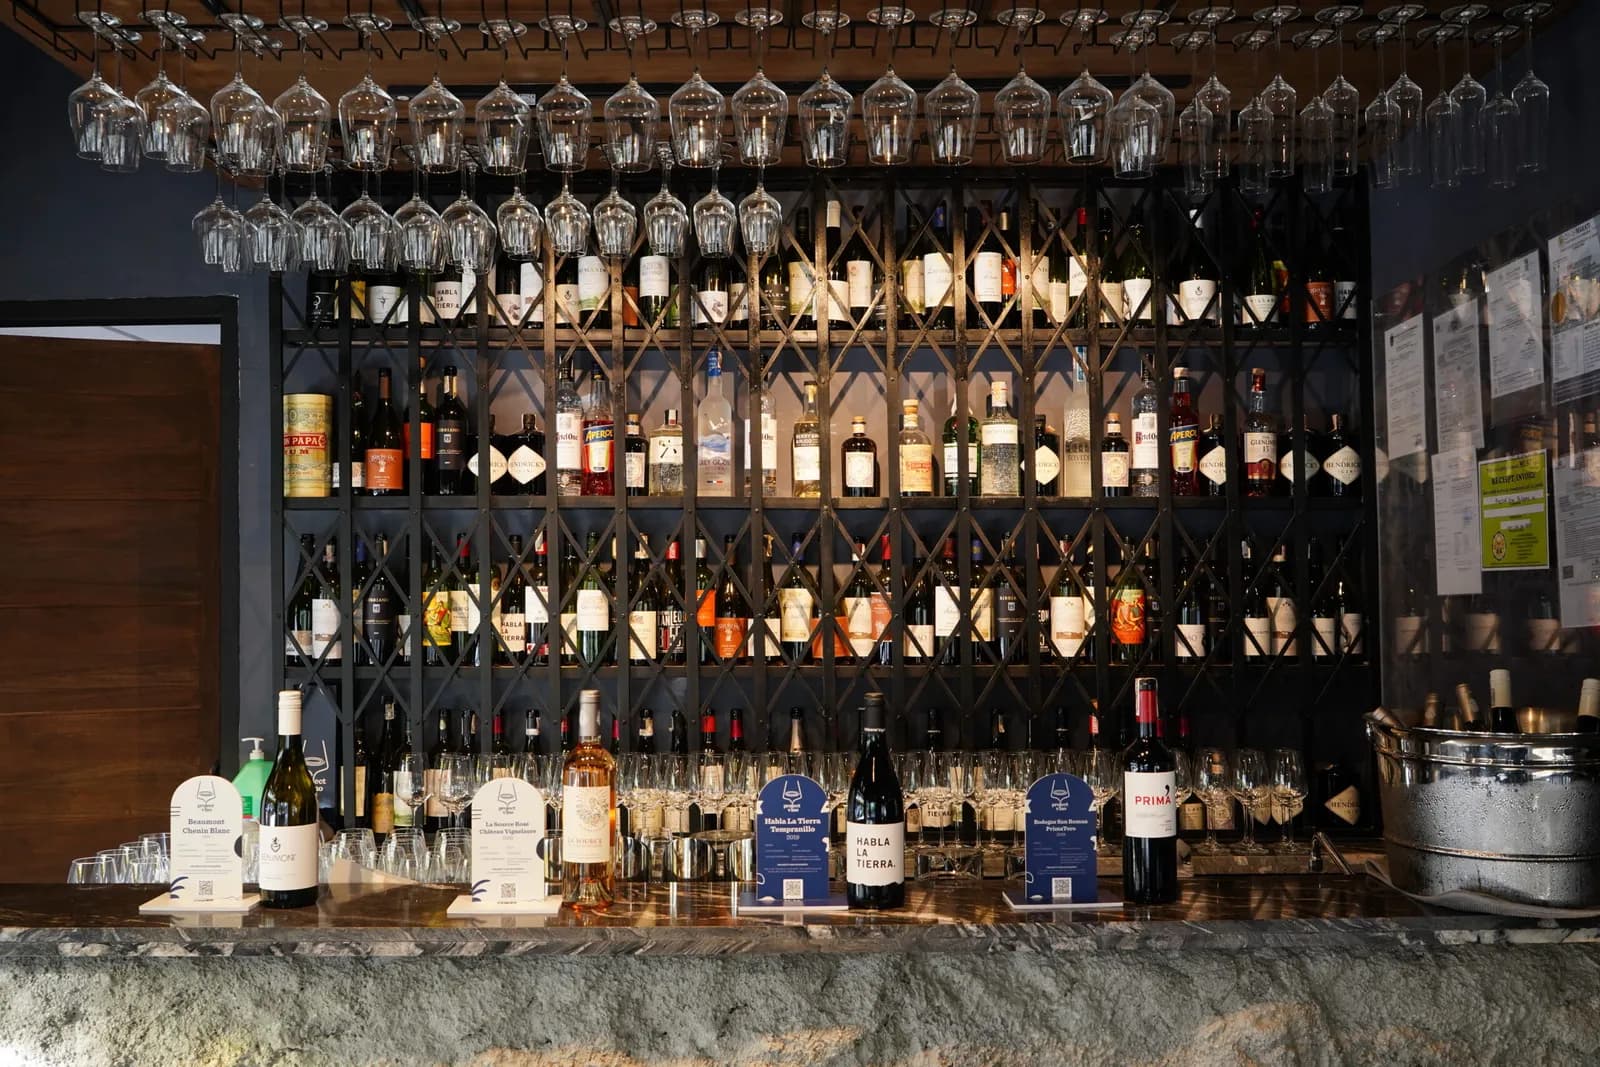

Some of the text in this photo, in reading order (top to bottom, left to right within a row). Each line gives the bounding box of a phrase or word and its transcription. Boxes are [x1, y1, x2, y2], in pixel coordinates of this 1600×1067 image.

[292, 434, 318, 446] PAPA
[586, 430, 613, 441] APEROL
[1170, 430, 1198, 442] APEROL
[764, 817, 822, 825] Habla La Tierra
[182, 826, 231, 834] Chenin Blanc
[856, 837, 890, 847] HABLA
[856, 848, 868, 857] LA
